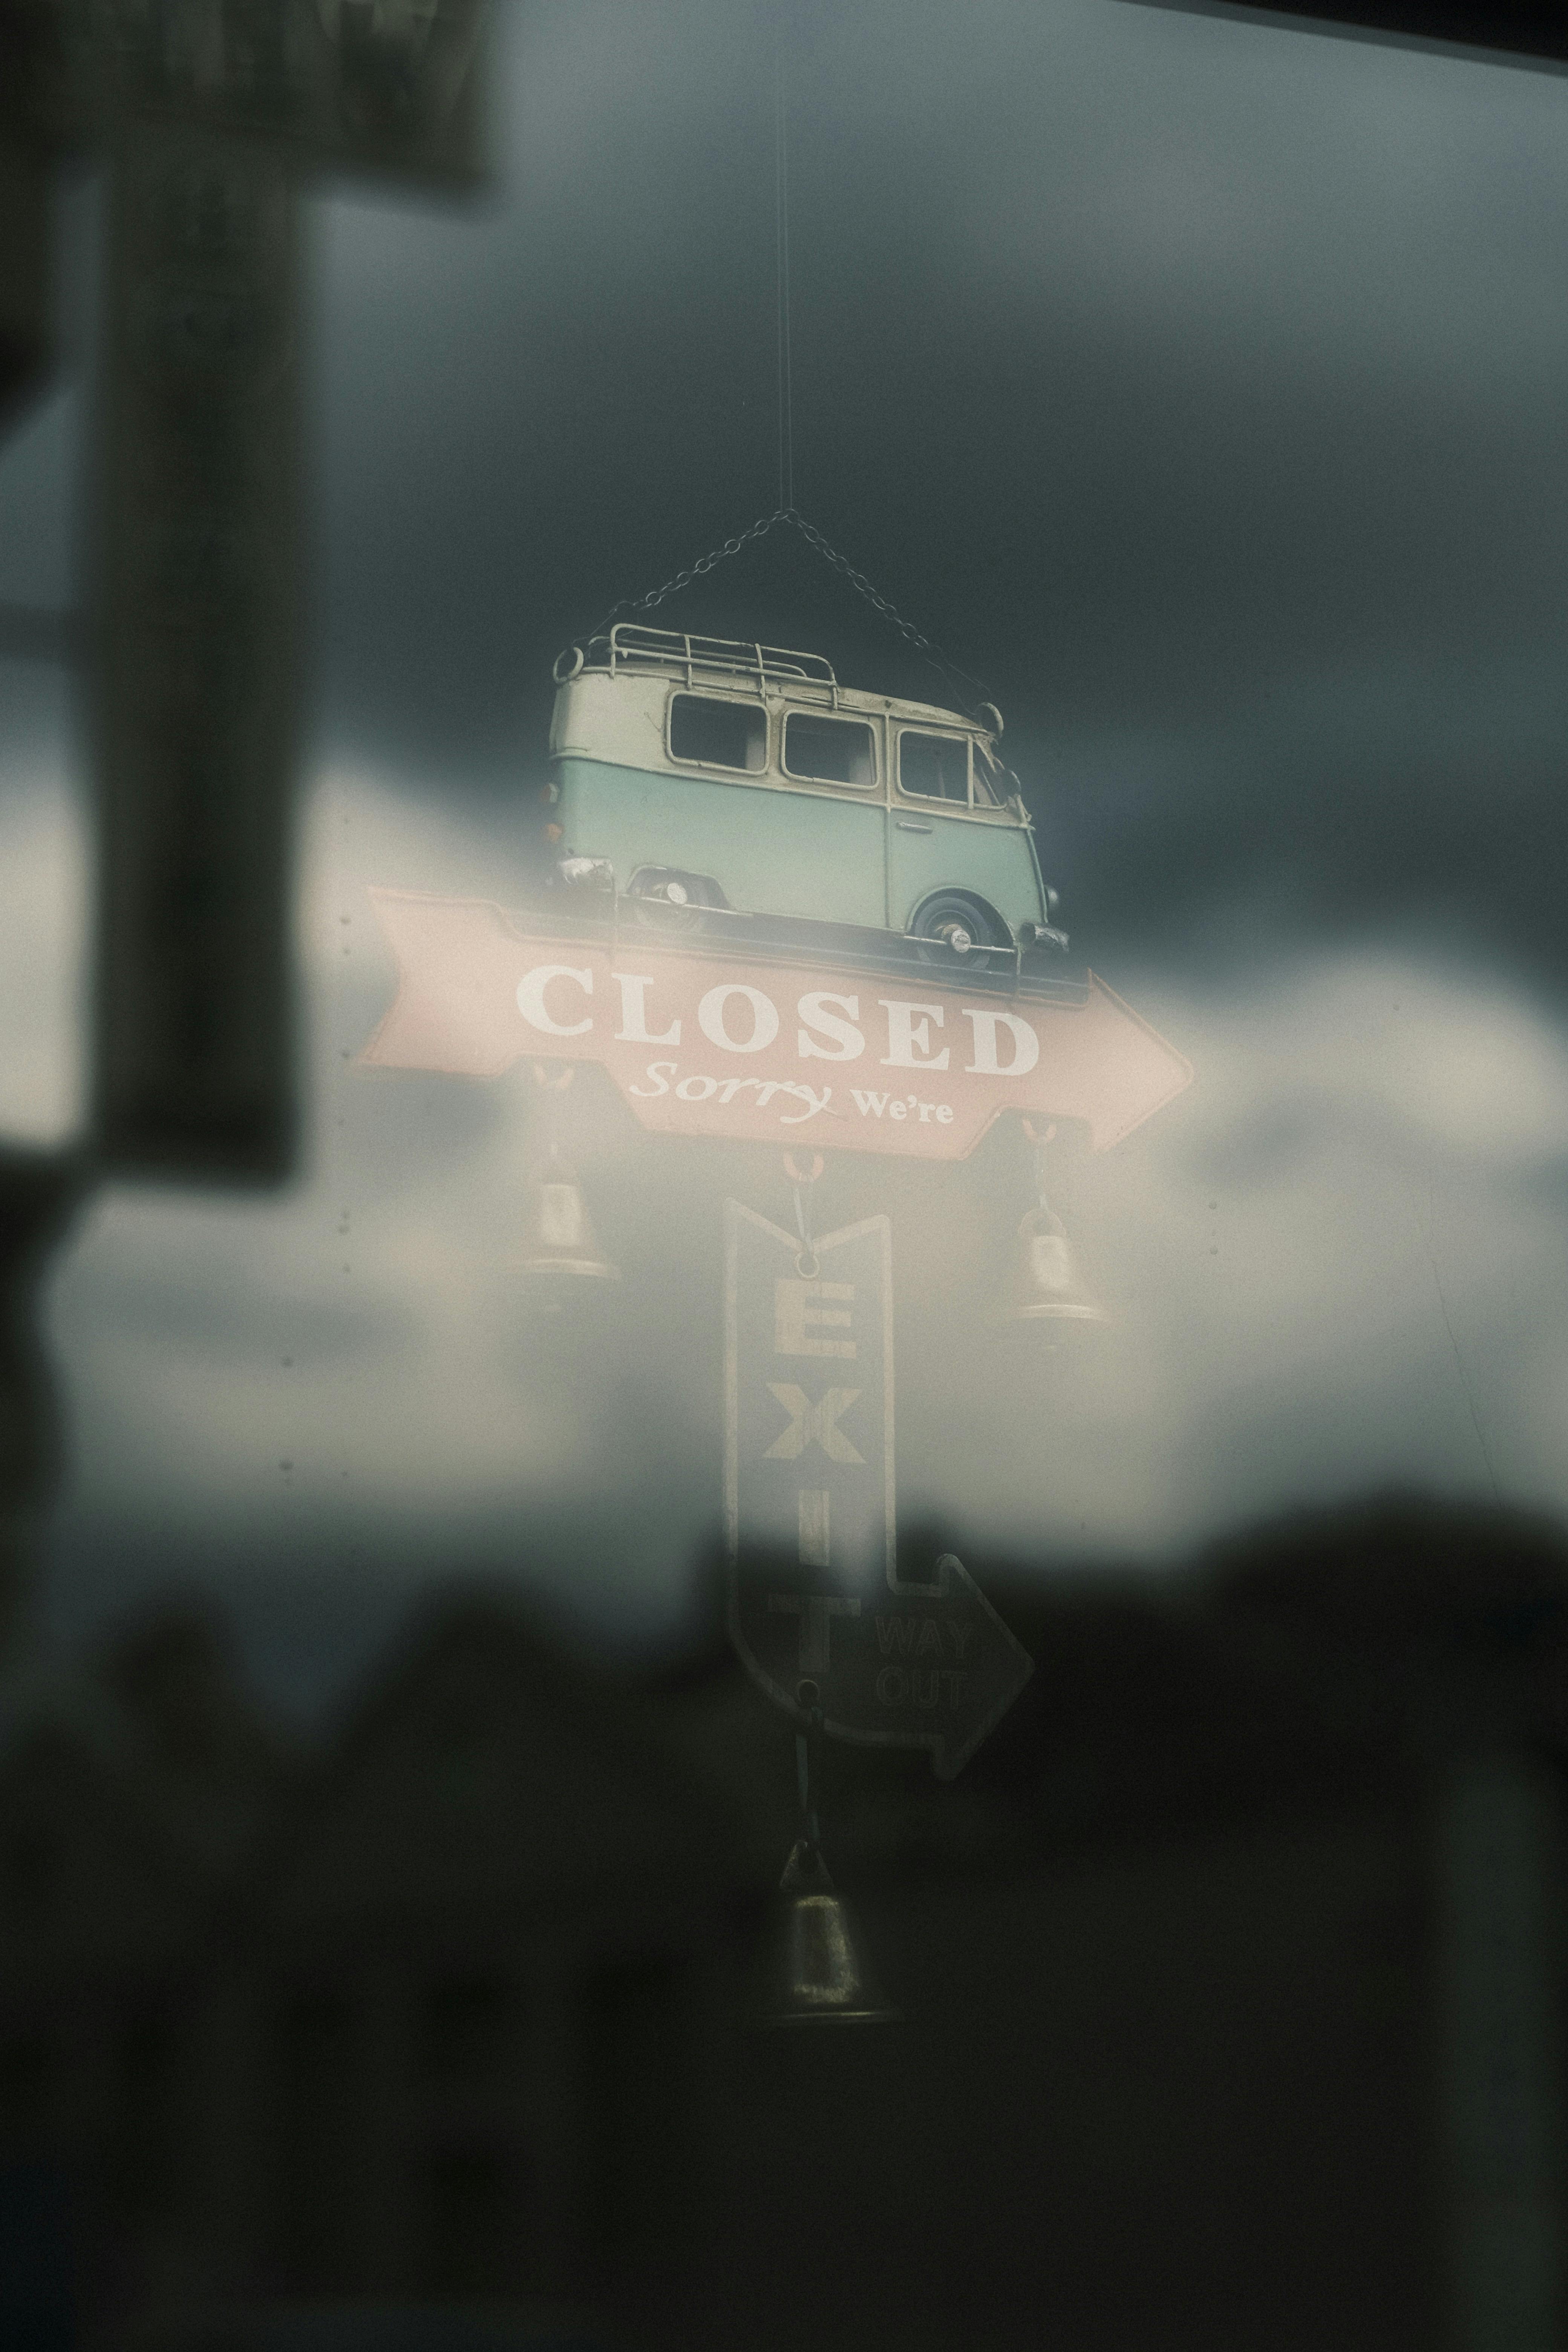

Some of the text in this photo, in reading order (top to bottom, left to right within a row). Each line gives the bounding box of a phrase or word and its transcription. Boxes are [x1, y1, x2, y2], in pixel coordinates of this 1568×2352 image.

[516, 965, 1040, 1076] CLOSED
[629, 1061, 954, 1123] Sorry We're
[762, 1278, 867, 1672] EXIT
[875, 1615, 973, 1658] WAY
[876, 1666, 967, 1710] OUT
